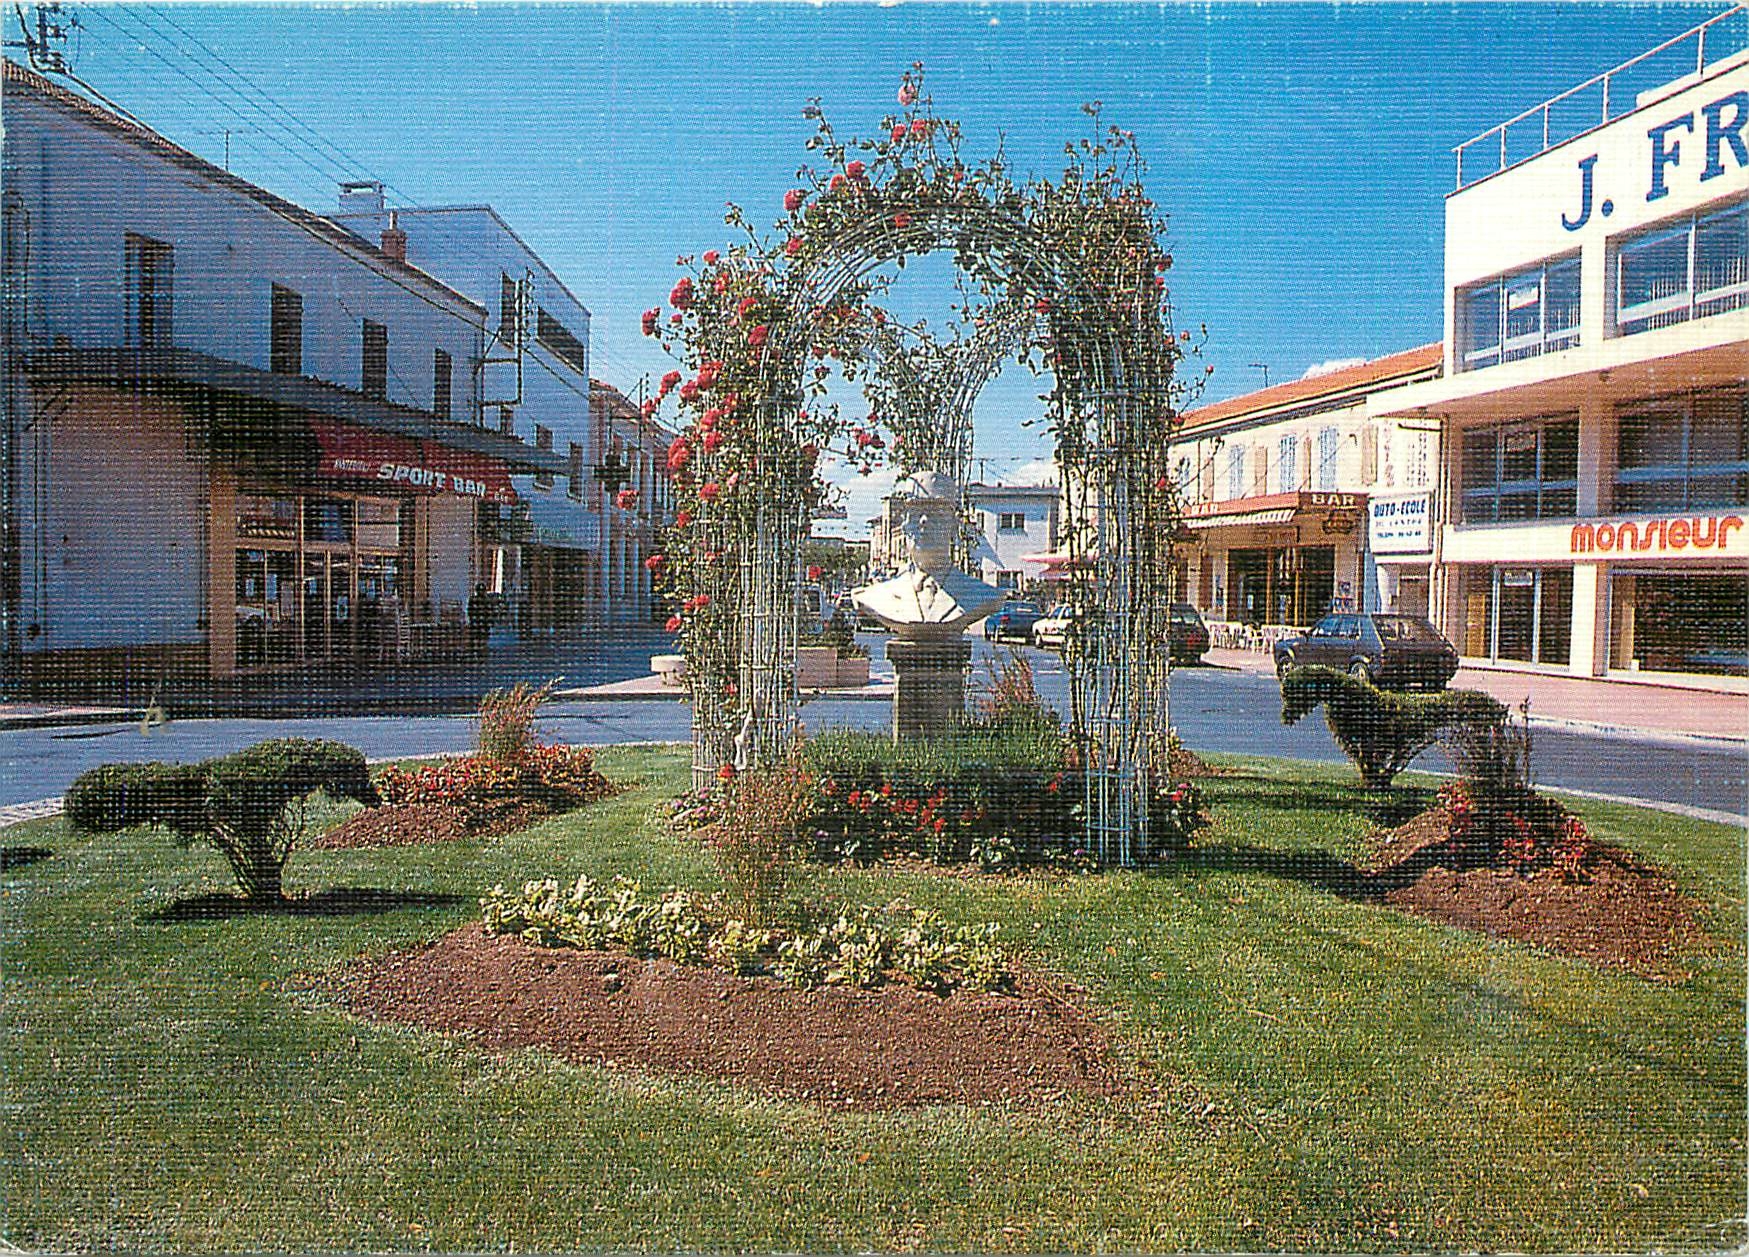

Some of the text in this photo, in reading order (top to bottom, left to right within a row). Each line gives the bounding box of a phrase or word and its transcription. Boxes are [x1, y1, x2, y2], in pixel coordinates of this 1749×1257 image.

[1562, 154, 1614, 231] J.
[377, 463, 447, 489] SPORT
[453, 477, 486, 497] BAR
[1191, 504, 1218, 515] BAR
[1311, 494, 1355, 505] BAR
[1571, 516, 1744, 552] monsieur
